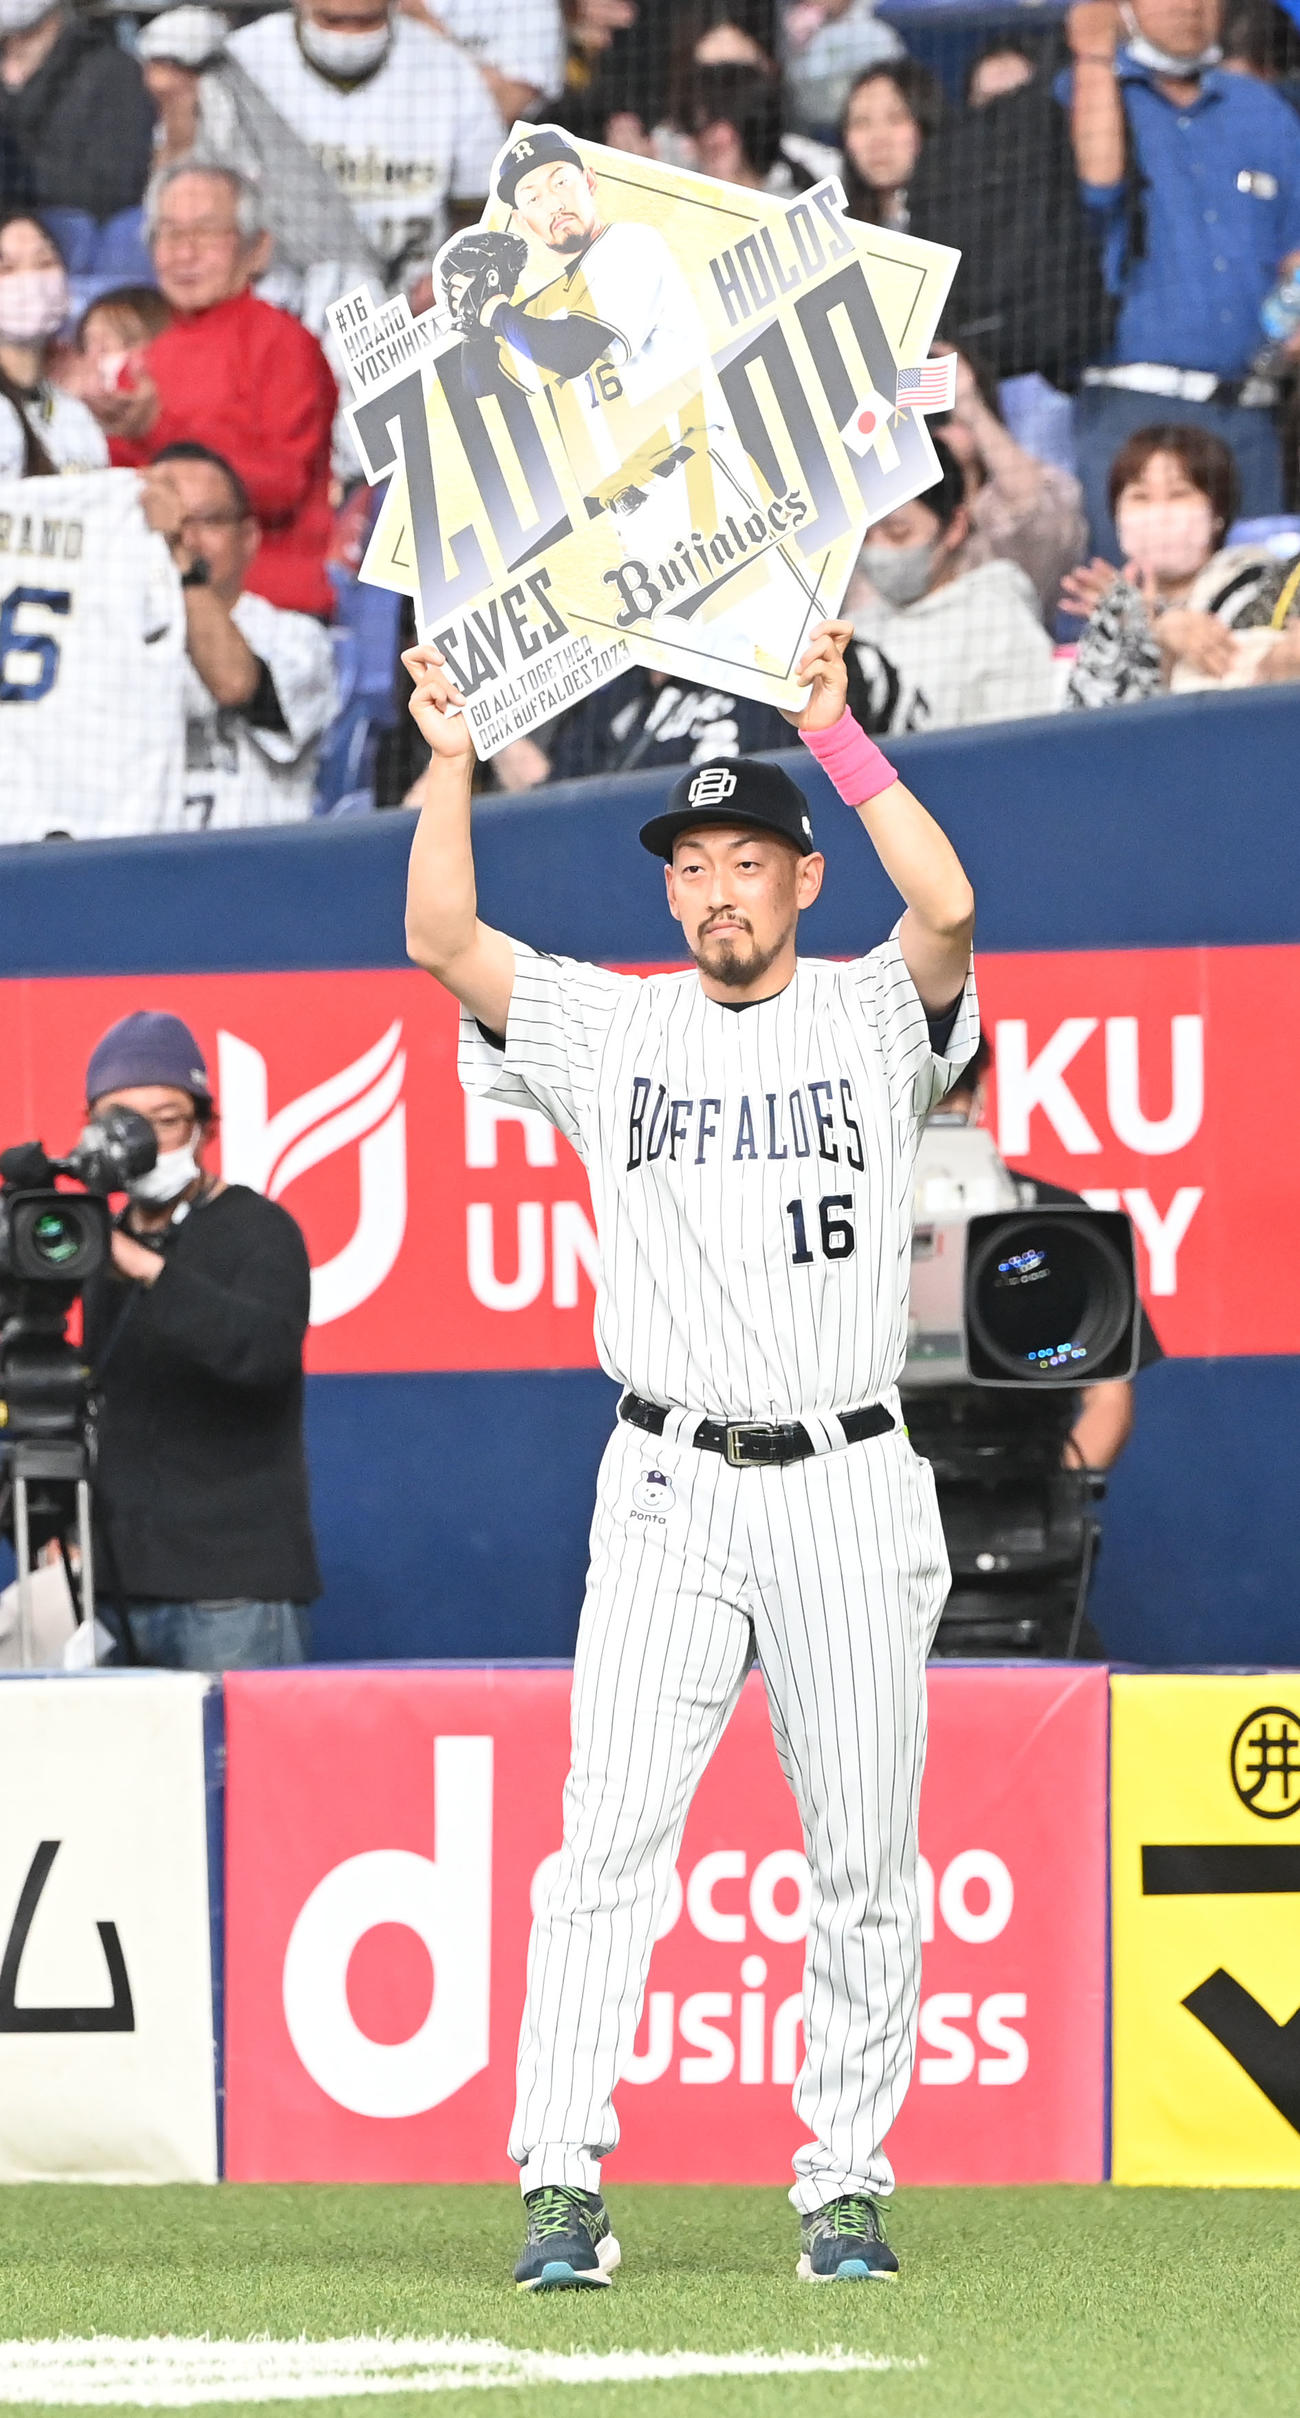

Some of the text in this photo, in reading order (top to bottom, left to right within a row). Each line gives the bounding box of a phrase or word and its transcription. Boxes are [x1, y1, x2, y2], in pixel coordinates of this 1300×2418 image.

[709, 184, 855, 327] HOLDS
[335, 296, 368, 334] #16
[354, 316, 444, 386] YOSHIHISA
[585, 362, 623, 408] 16
[603, 490, 807, 627] Buffaloes
[433, 567, 569, 697] SAVES
[470, 700, 492, 727] GO
[479, 715, 513, 750] ORIX
[513, 664, 592, 729] BUFFALOES
[591, 639, 631, 677] 2023
[627, 1077, 865, 1172] BUFFALOES
[786, 1193, 855, 1264] 16
